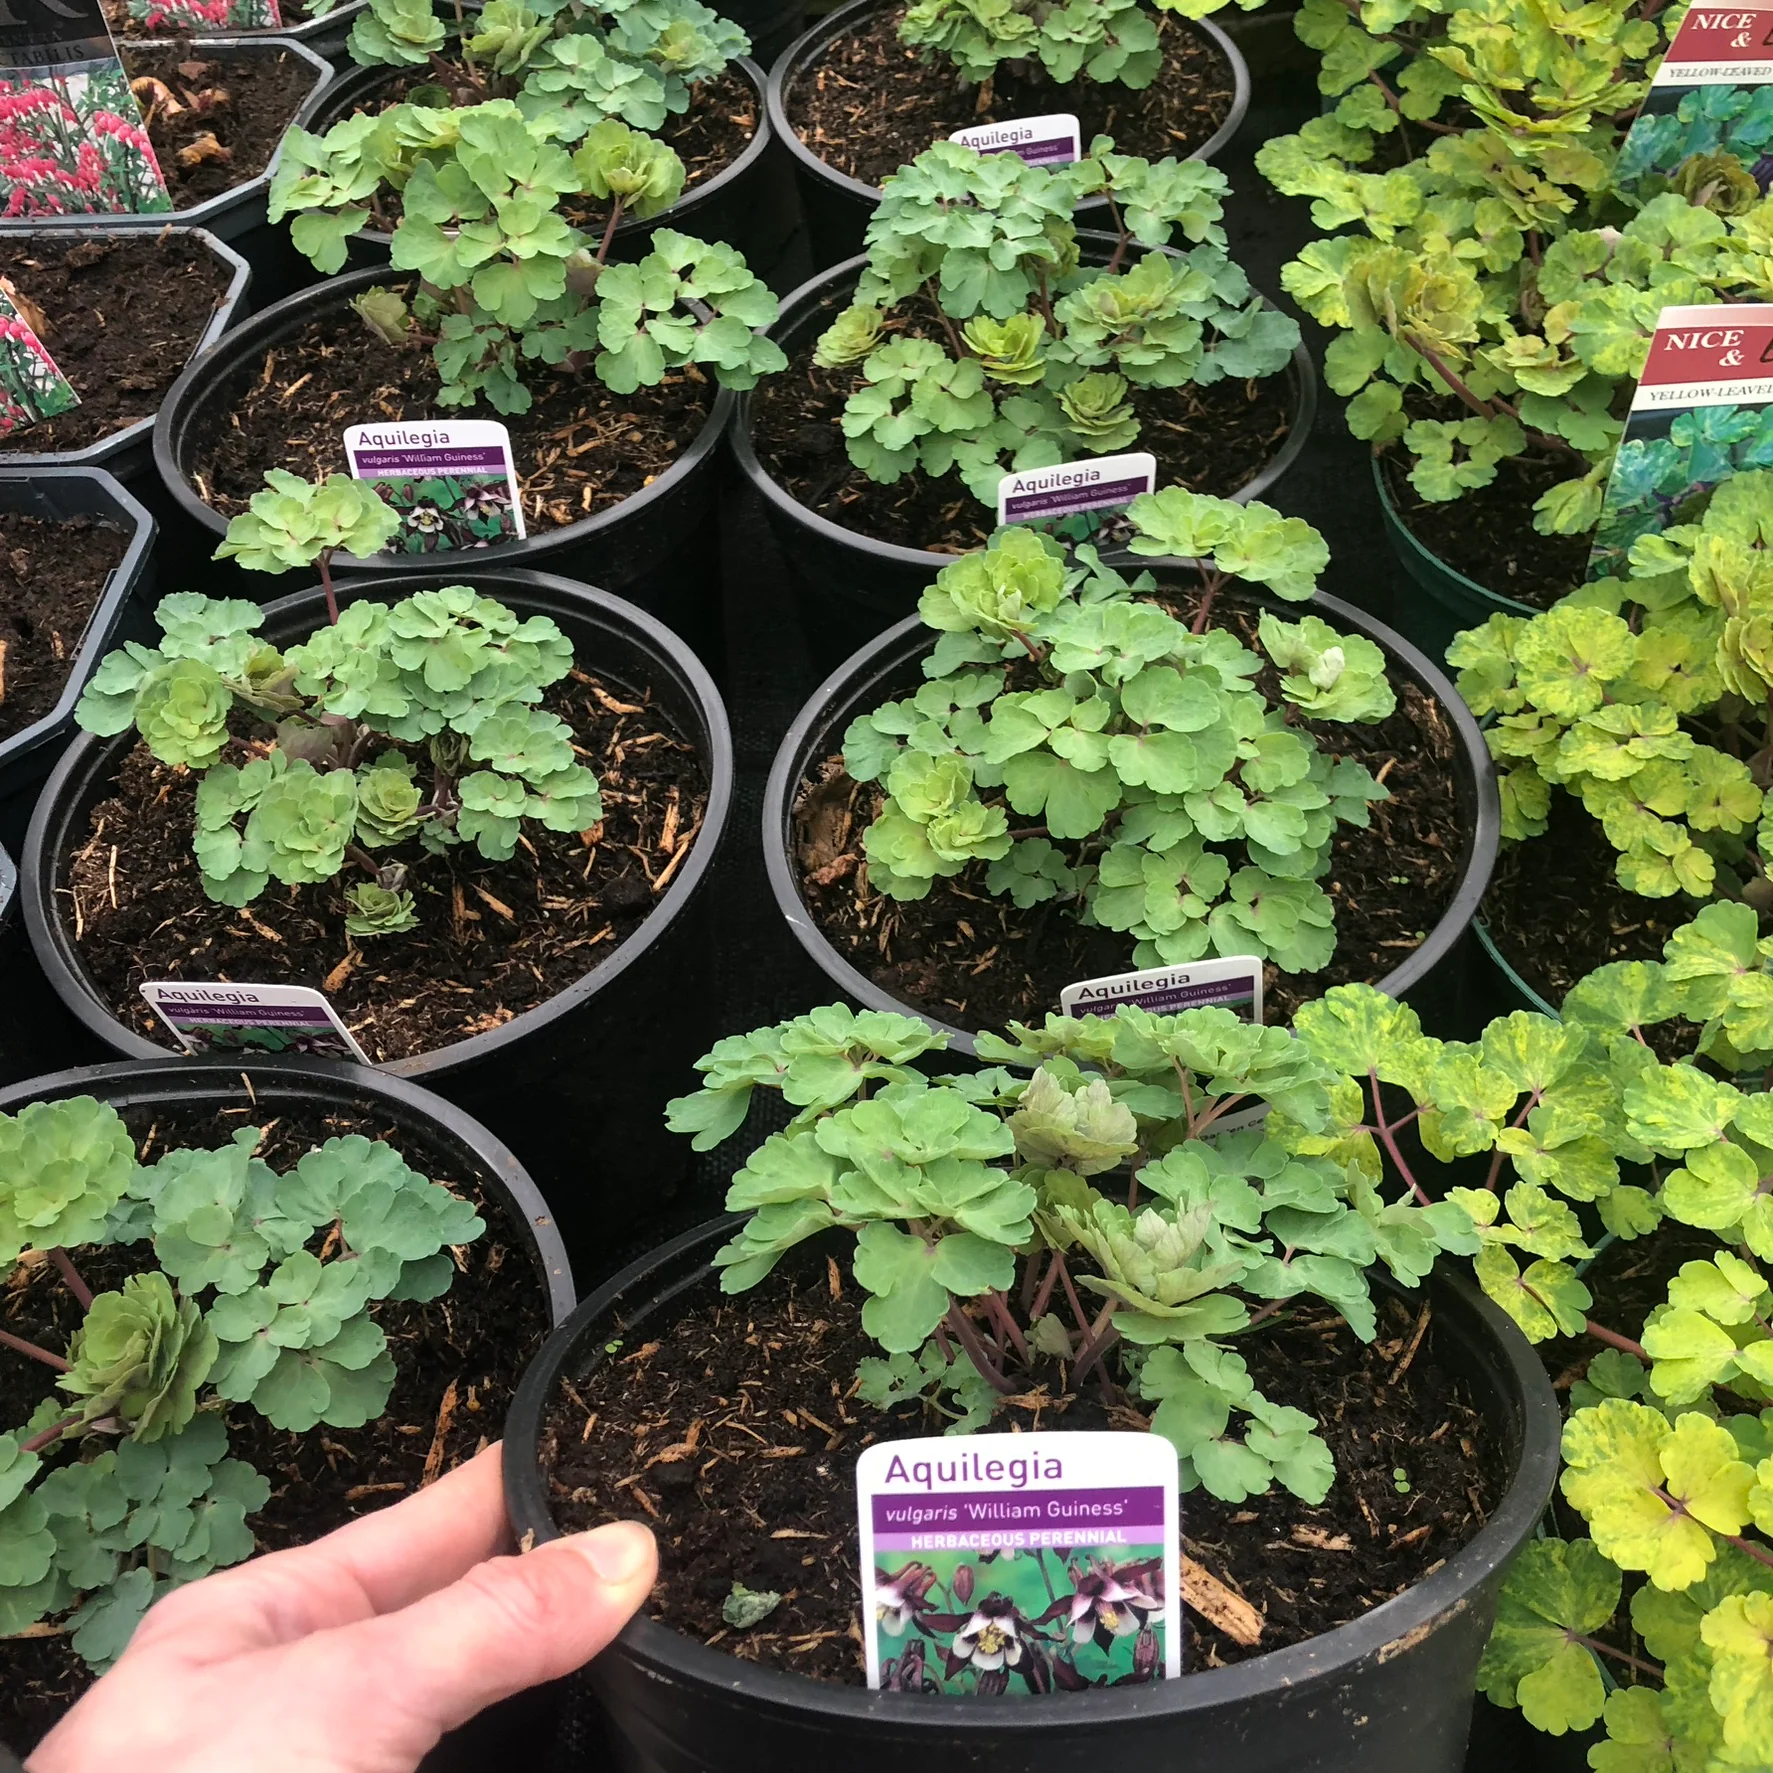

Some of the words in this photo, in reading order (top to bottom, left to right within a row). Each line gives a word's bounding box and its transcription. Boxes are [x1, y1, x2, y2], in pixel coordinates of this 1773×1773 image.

[1691, 13, 1756, 30] NICE
[1730, 32, 1752, 48] &
[1670, 66, 1773, 78] YELLOW-LEAVED
[961, 127, 1033, 149] Aquilegia
[1664, 329, 1744, 351] NICE
[1718, 349, 1745, 367] &
[358, 430, 450, 449] Aquilegia
[361, 455, 400, 466] vulgaris
[377, 467, 436, 478] HERBACEOUS
[438, 466, 488, 475] PERENNIAL
[1012, 469, 1101, 494] Aquilegia
[157, 988, 260, 1005] Aquilegia
[1078, 973, 1190, 1001] Aquilegia
[884, 1451, 1063, 1490] Aquilegia
[886, 1505, 958, 1523] vulgaris
[964, 1500, 1041, 1520] 'William
[1047, 1498, 1129, 1518] Guiness'
[911, 1533, 1025, 1550] HERBACEOUS
[1029, 1529, 1127, 1546] PERENNIAL
